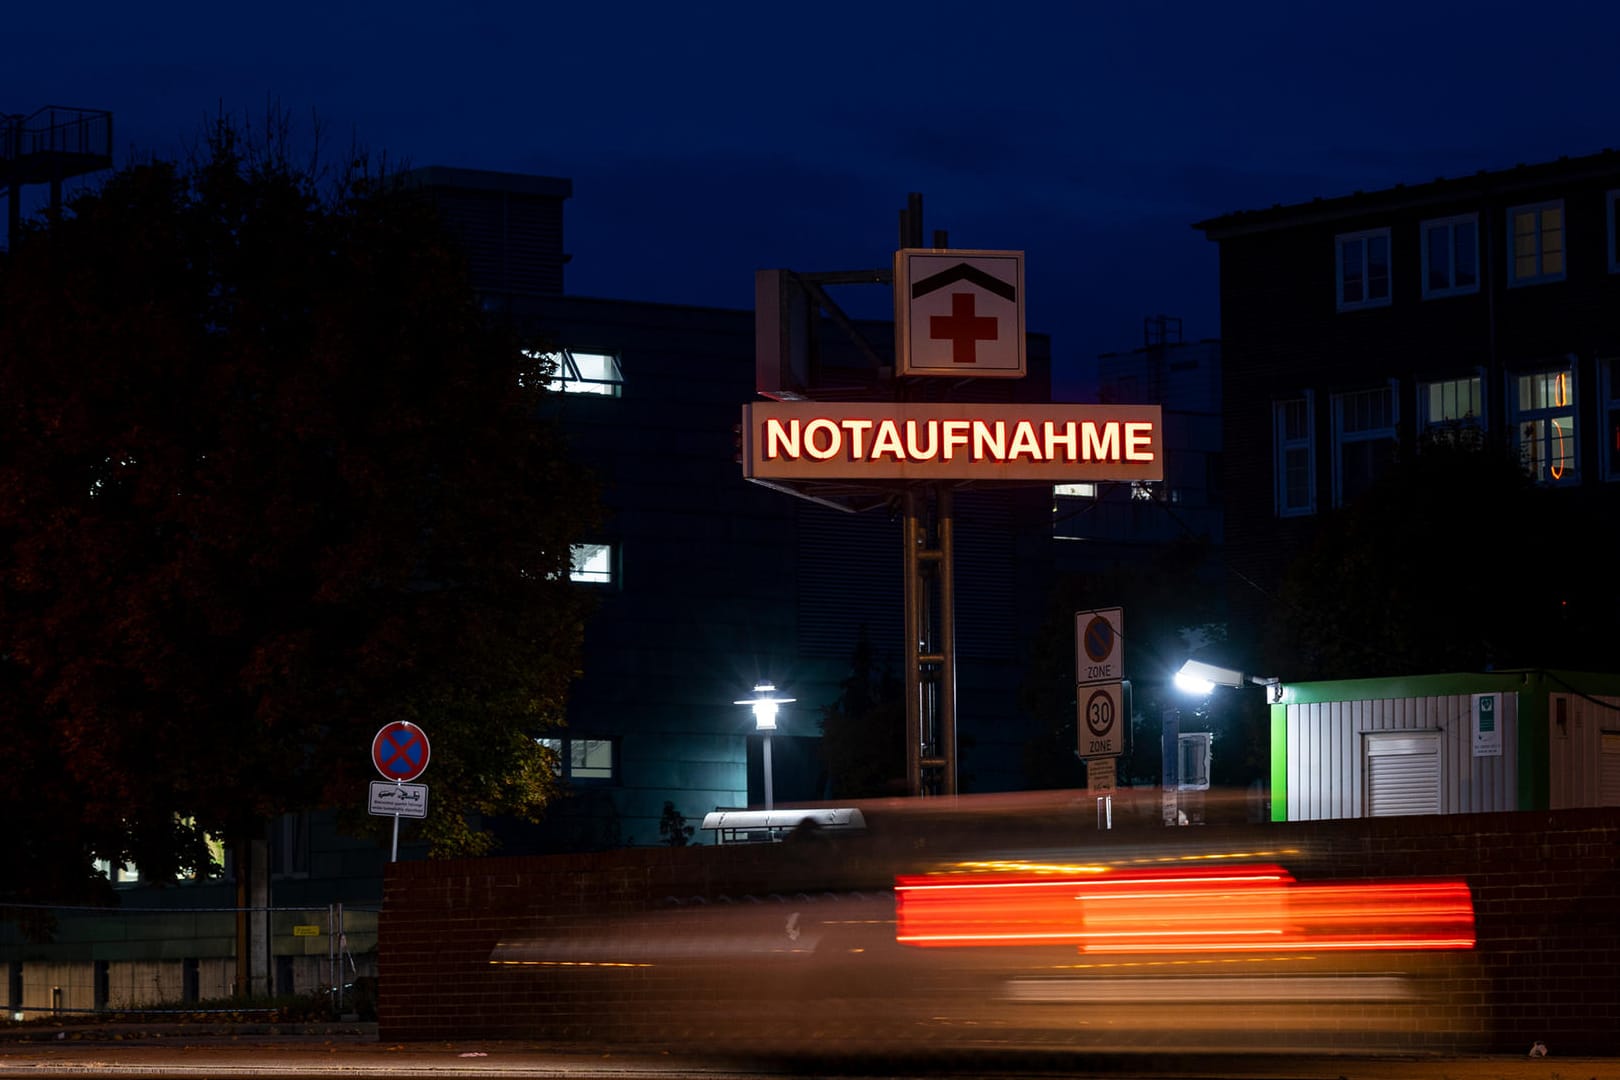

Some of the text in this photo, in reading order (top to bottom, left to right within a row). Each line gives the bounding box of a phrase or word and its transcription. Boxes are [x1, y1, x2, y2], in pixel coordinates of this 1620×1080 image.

[766, 418, 1155, 463] NOTAUFNAHME
[1087, 664, 1111, 679] ZONE
[1091, 702, 1109, 724] 30
[1089, 739, 1112, 753] ZONE
